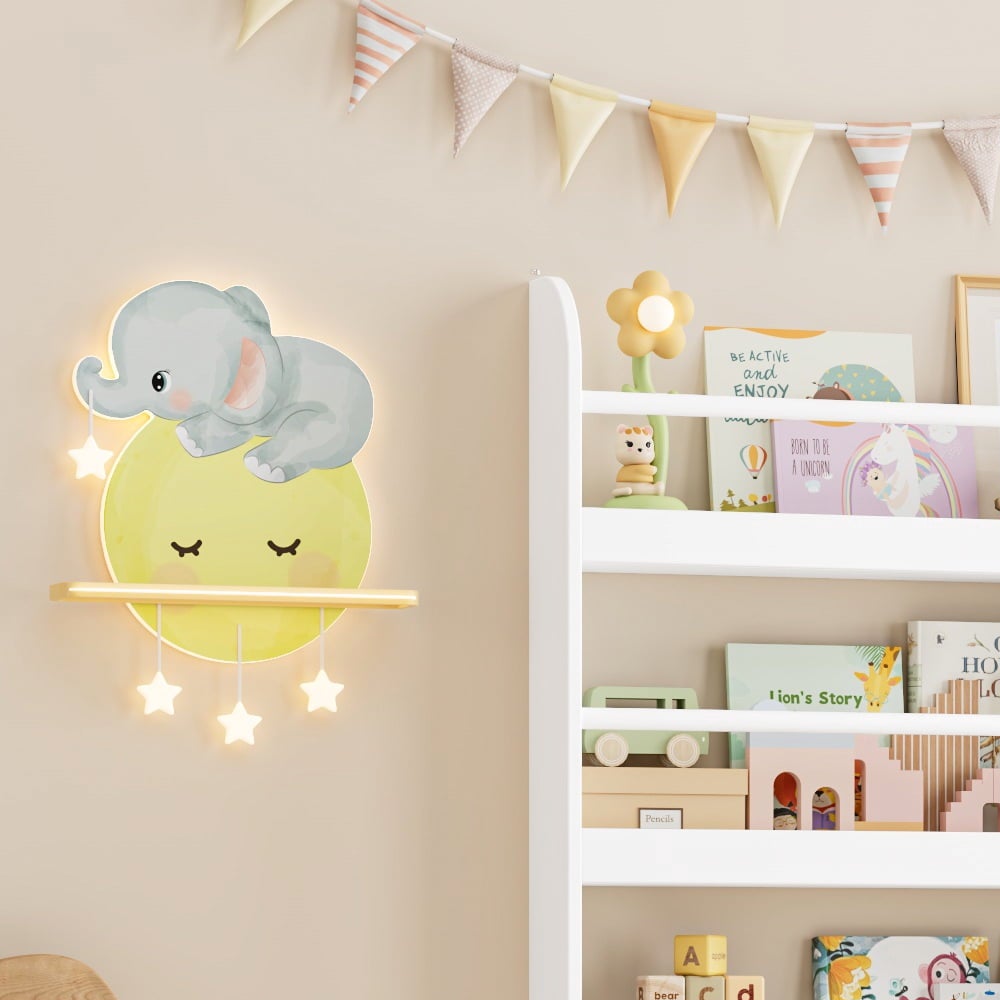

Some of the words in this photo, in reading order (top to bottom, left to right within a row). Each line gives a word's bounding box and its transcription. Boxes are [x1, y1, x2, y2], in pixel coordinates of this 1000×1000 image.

[730, 352, 746, 362] BE
[749, 350, 790, 362] ACTIVE
[743, 364, 778, 380] and
[734, 383, 789, 399] ENJOY
[791, 438, 809, 455] BORN
[813, 438, 820, 455] TO
[822, 438, 831, 455] BE
[792, 459, 797, 475] A
[800, 460, 831, 477] UNICORN
[819, 691, 863, 709] Story
[645, 814, 674, 823] Pencils
[683, 946, 700, 966] A
[654, 991, 680, 1000] bear
